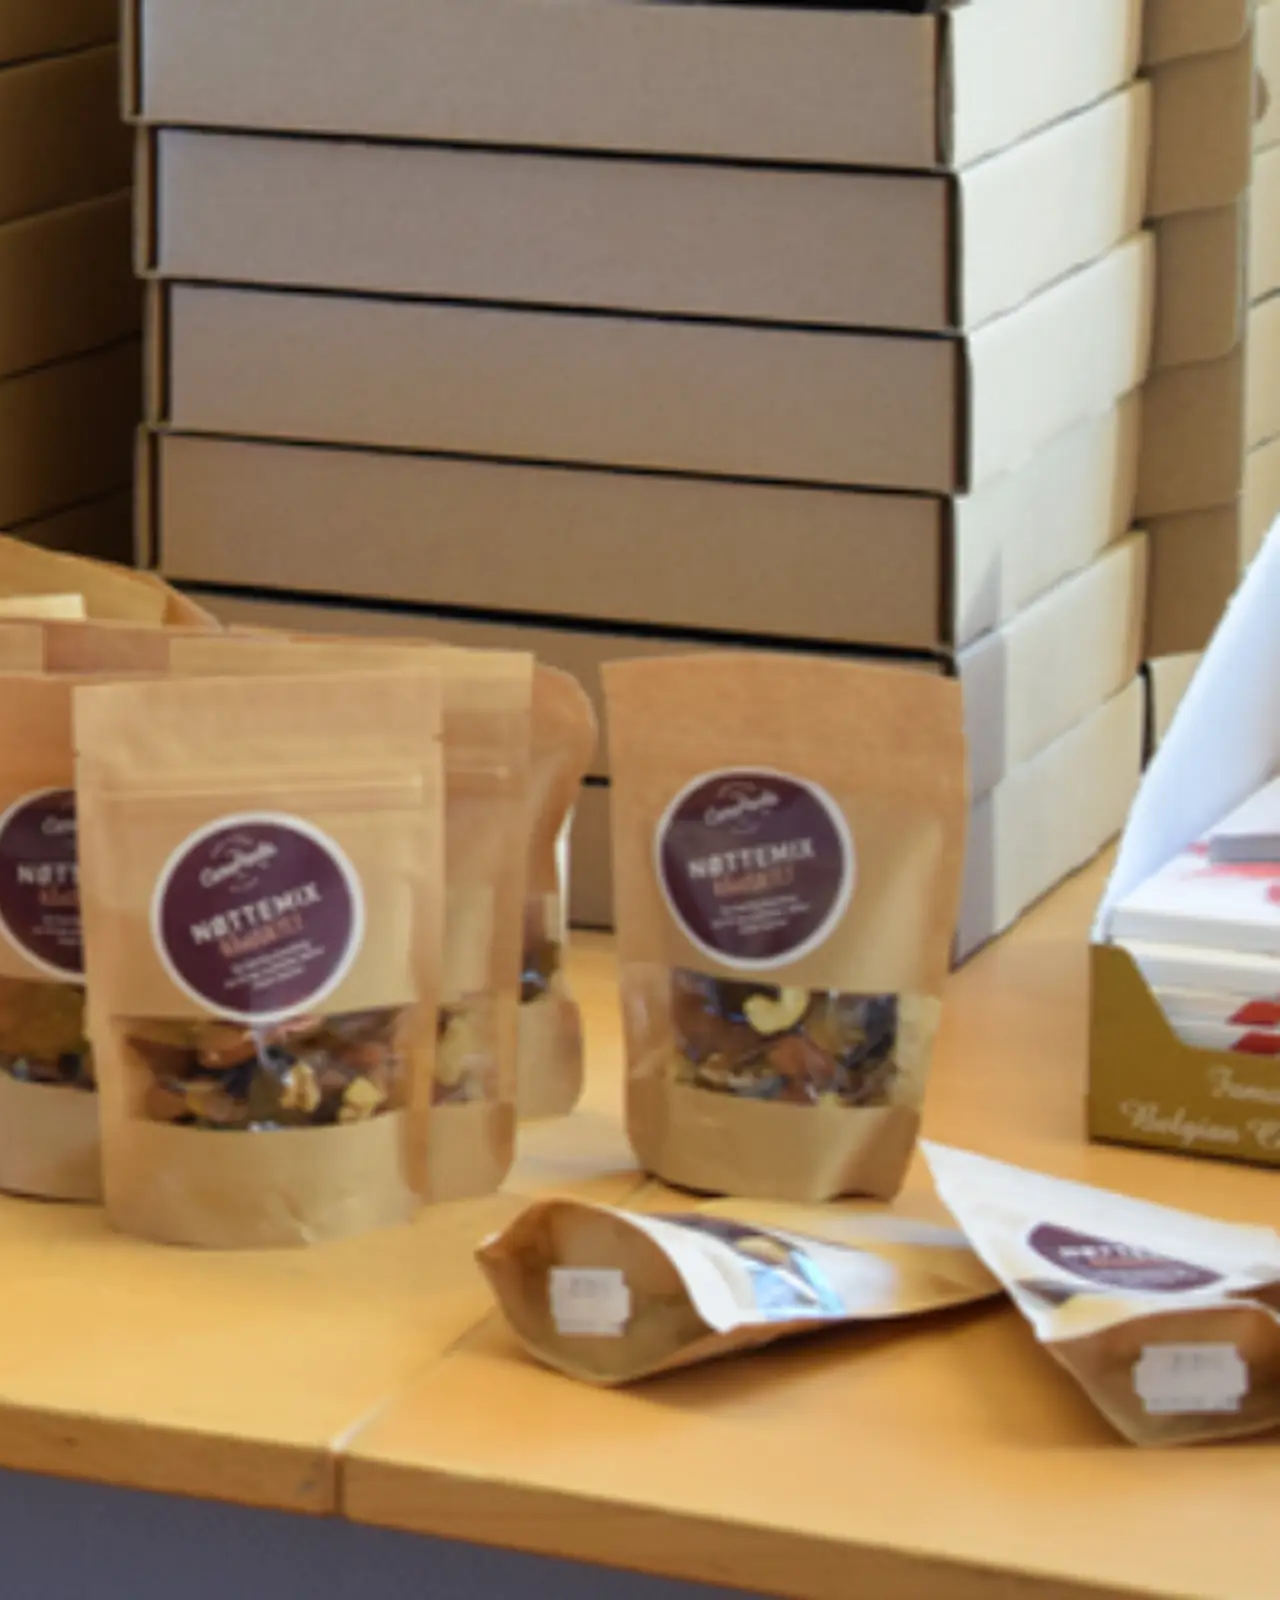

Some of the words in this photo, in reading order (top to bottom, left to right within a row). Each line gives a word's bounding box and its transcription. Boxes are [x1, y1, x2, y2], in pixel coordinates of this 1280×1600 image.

[688, 836, 814, 880] NØTTEMIX
[191, 882, 321, 946] NØTTEMIX
[1119, 1098, 1240, 1148] Belgian
